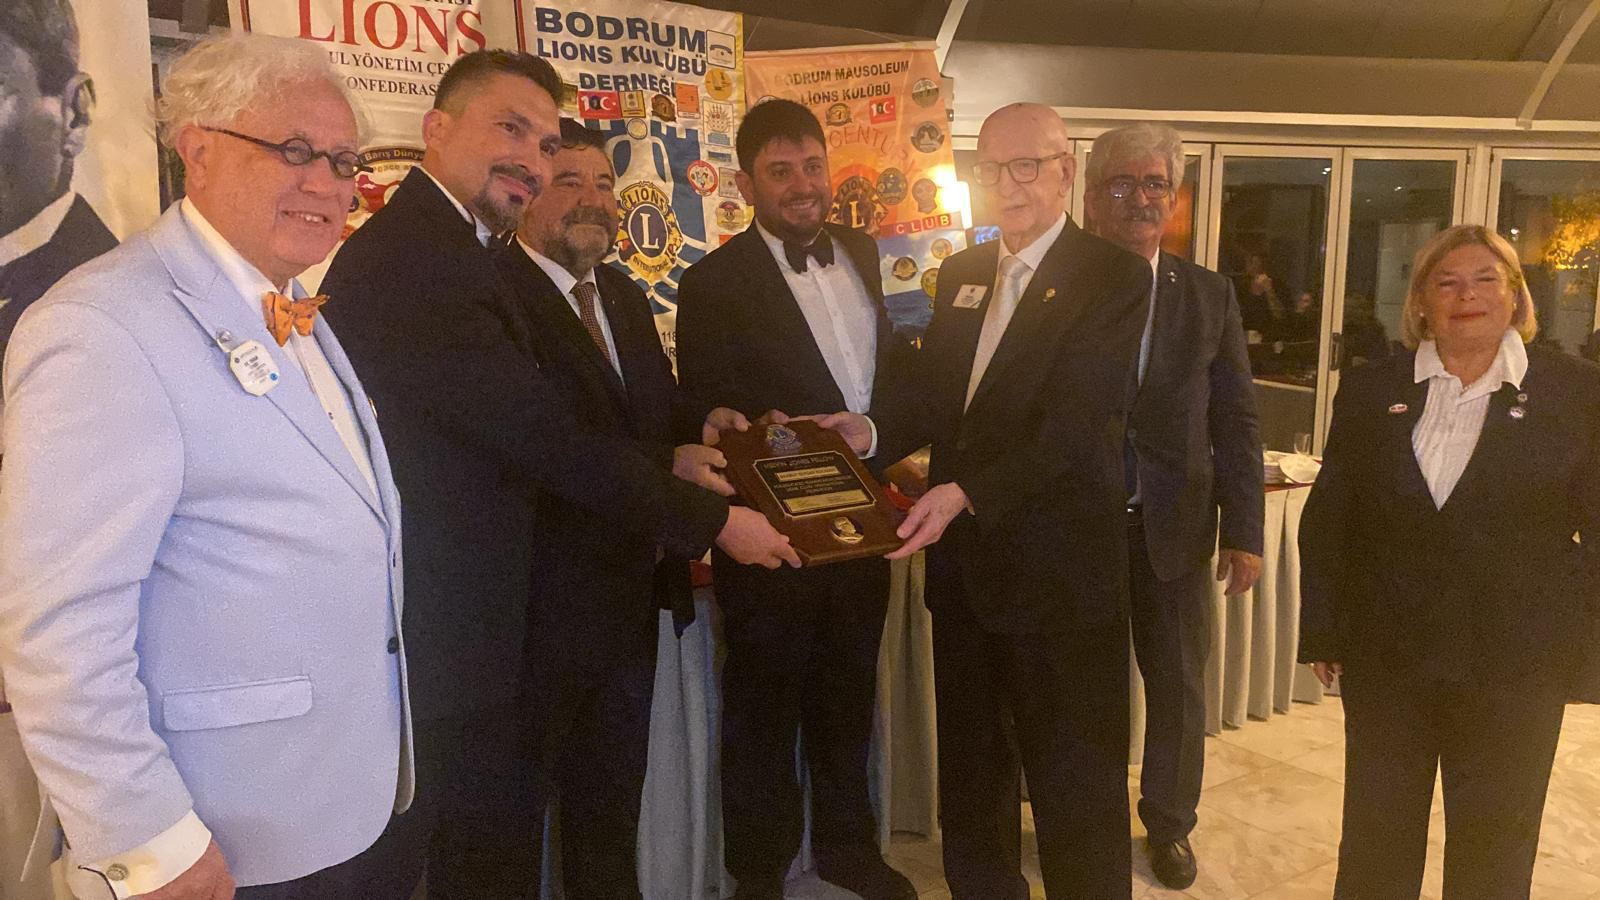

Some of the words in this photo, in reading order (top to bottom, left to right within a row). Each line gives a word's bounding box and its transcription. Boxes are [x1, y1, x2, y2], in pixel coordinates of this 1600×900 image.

[298, 0, 486, 56] LIONS
[535, 7, 706, 54] BODRUM
[329, 51, 349, 65] UL
[352, 53, 422, 73] YÖNETİM
[537, 38, 613, 64] LIONS
[621, 45, 707, 76] KULÜBÜ
[835, 61, 910, 81] MAUSOLEUM
[346, 76, 440, 97] ONFEDERAS
[579, 72, 677, 98] DERNEĞİ
[842, 82, 891, 101] KULÜBÜ
[626, 187, 668, 211] LIONS
[640, 212, 660, 250] L
[896, 214, 950, 234] CLUB
